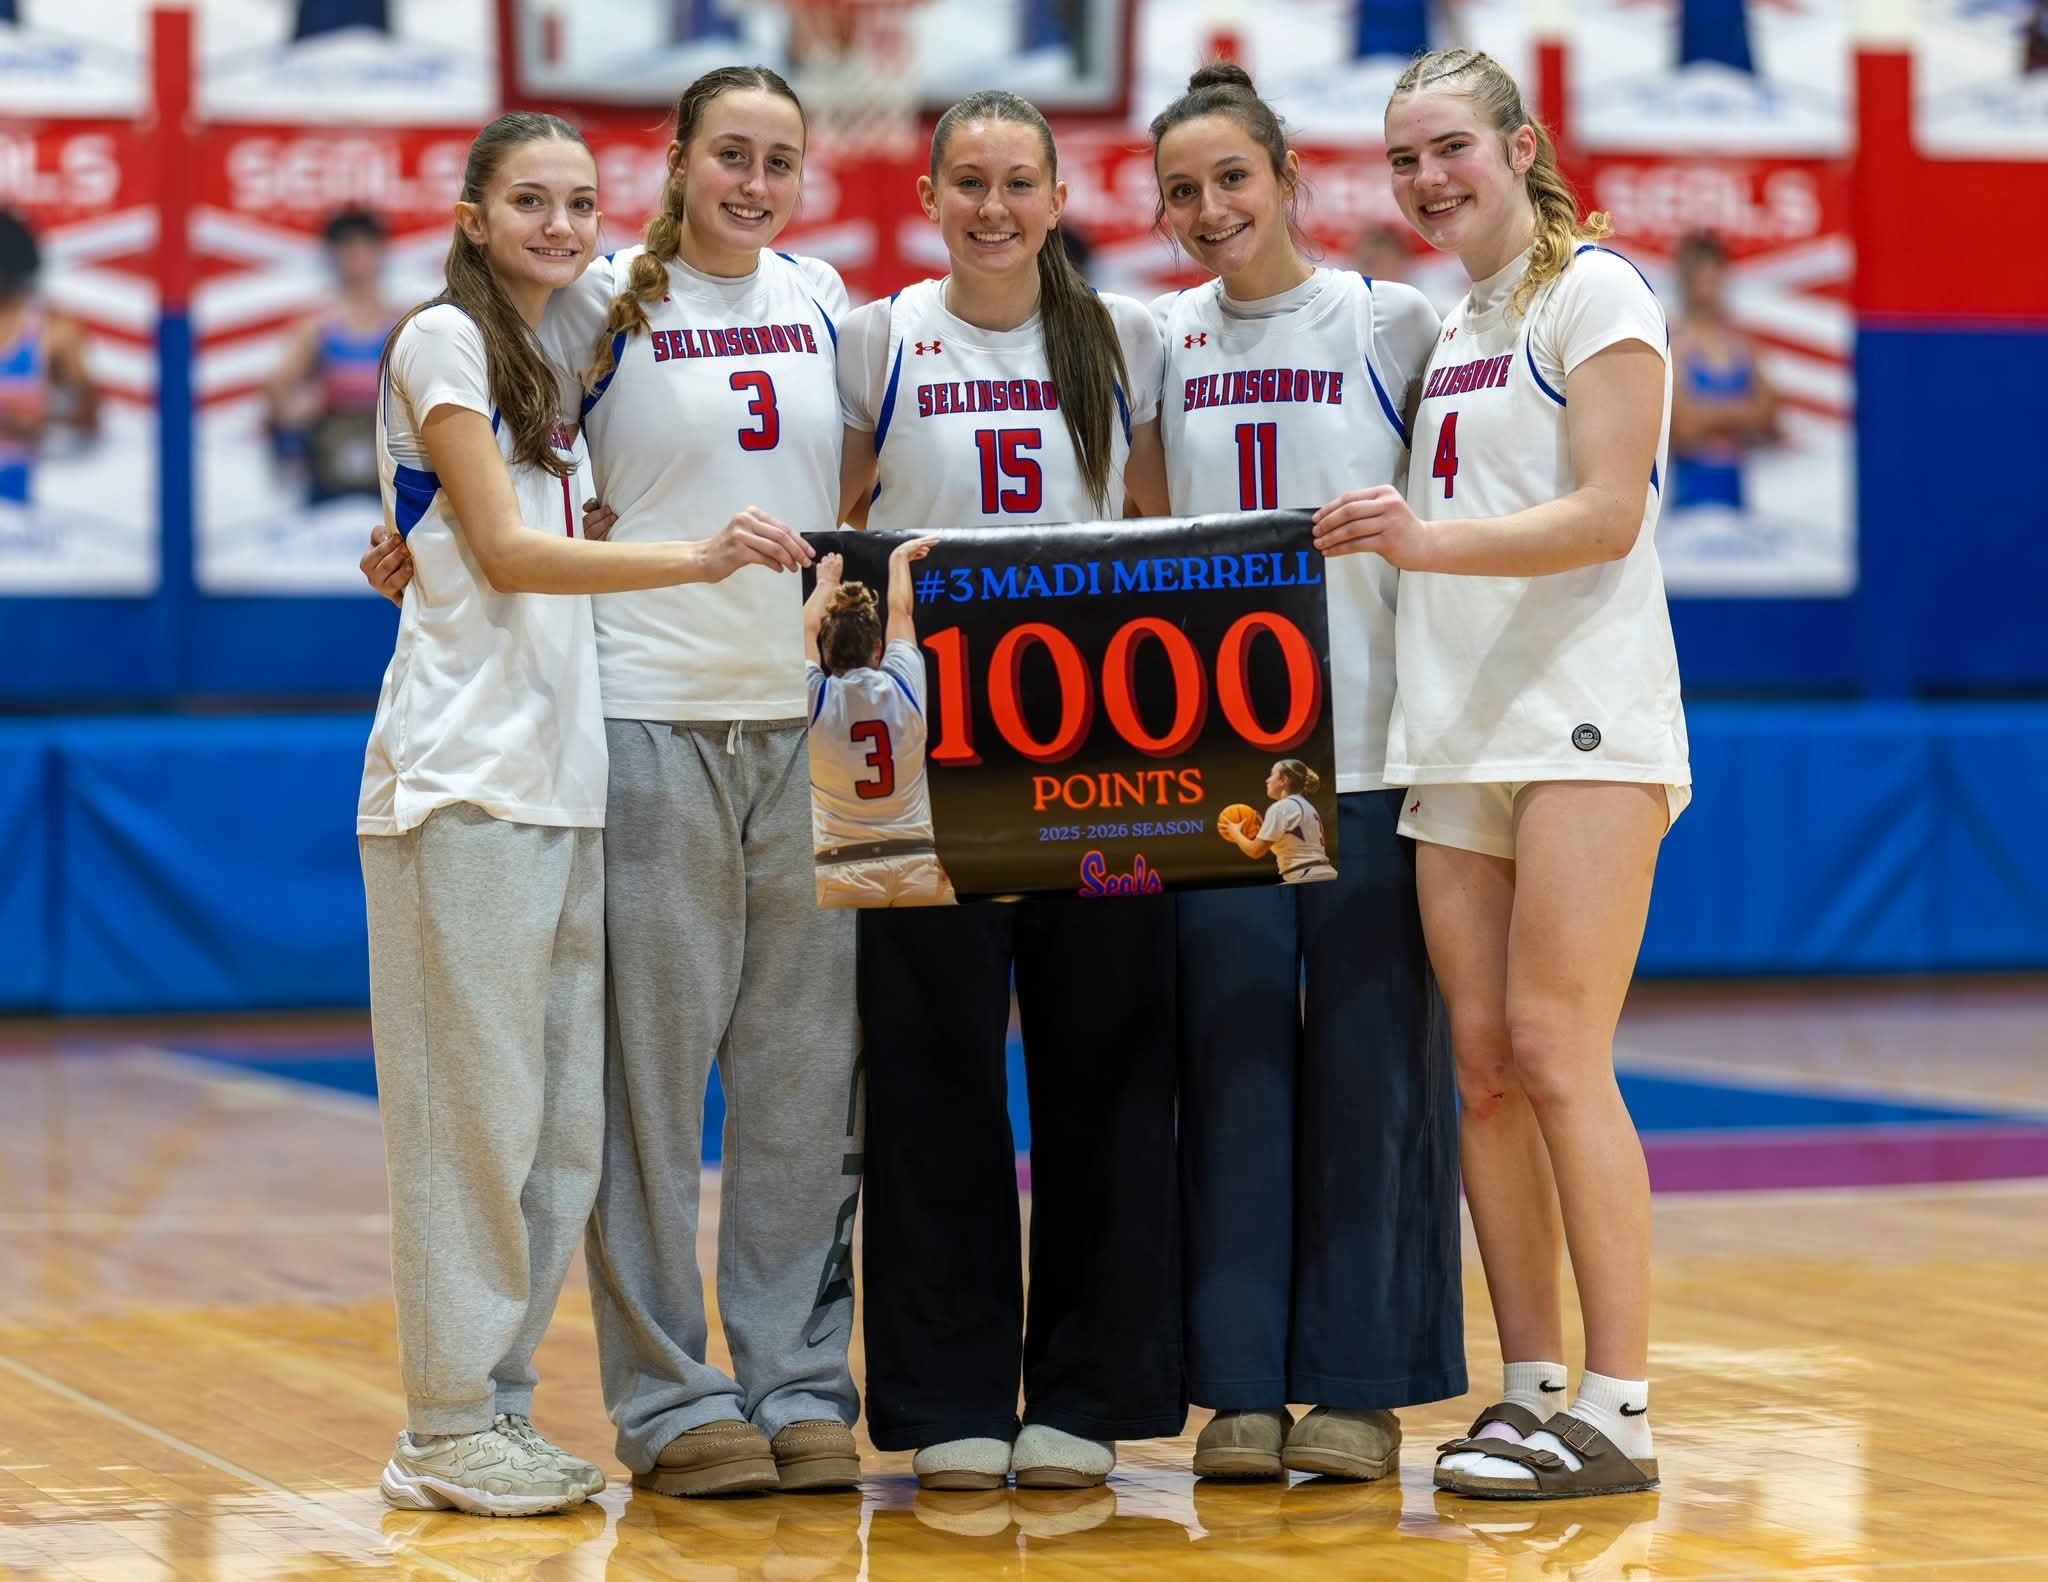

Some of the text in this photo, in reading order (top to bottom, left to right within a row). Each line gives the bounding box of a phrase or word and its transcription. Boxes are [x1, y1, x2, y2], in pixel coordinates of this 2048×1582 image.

[651, 323, 818, 362] SELINSGROVE
[729, 370, 780, 451] 3
[917, 379, 1058, 418] SELINSGRO
[1184, 368, 1344, 412] SELINSGROVE
[974, 427, 1043, 514] 15
[1235, 422, 1278, 511] 11
[1432, 411, 1459, 499] 4
[915, 551, 1321, 604] #3 MADI MERRELL
[922, 610, 1321, 764] 1000
[850, 719, 896, 800] 3
[1032, 768, 1204, 811] POINTS
[1039, 819, 1205, 841] 2025-2026 SEASON
[1078, 850, 1163, 897] Seals
